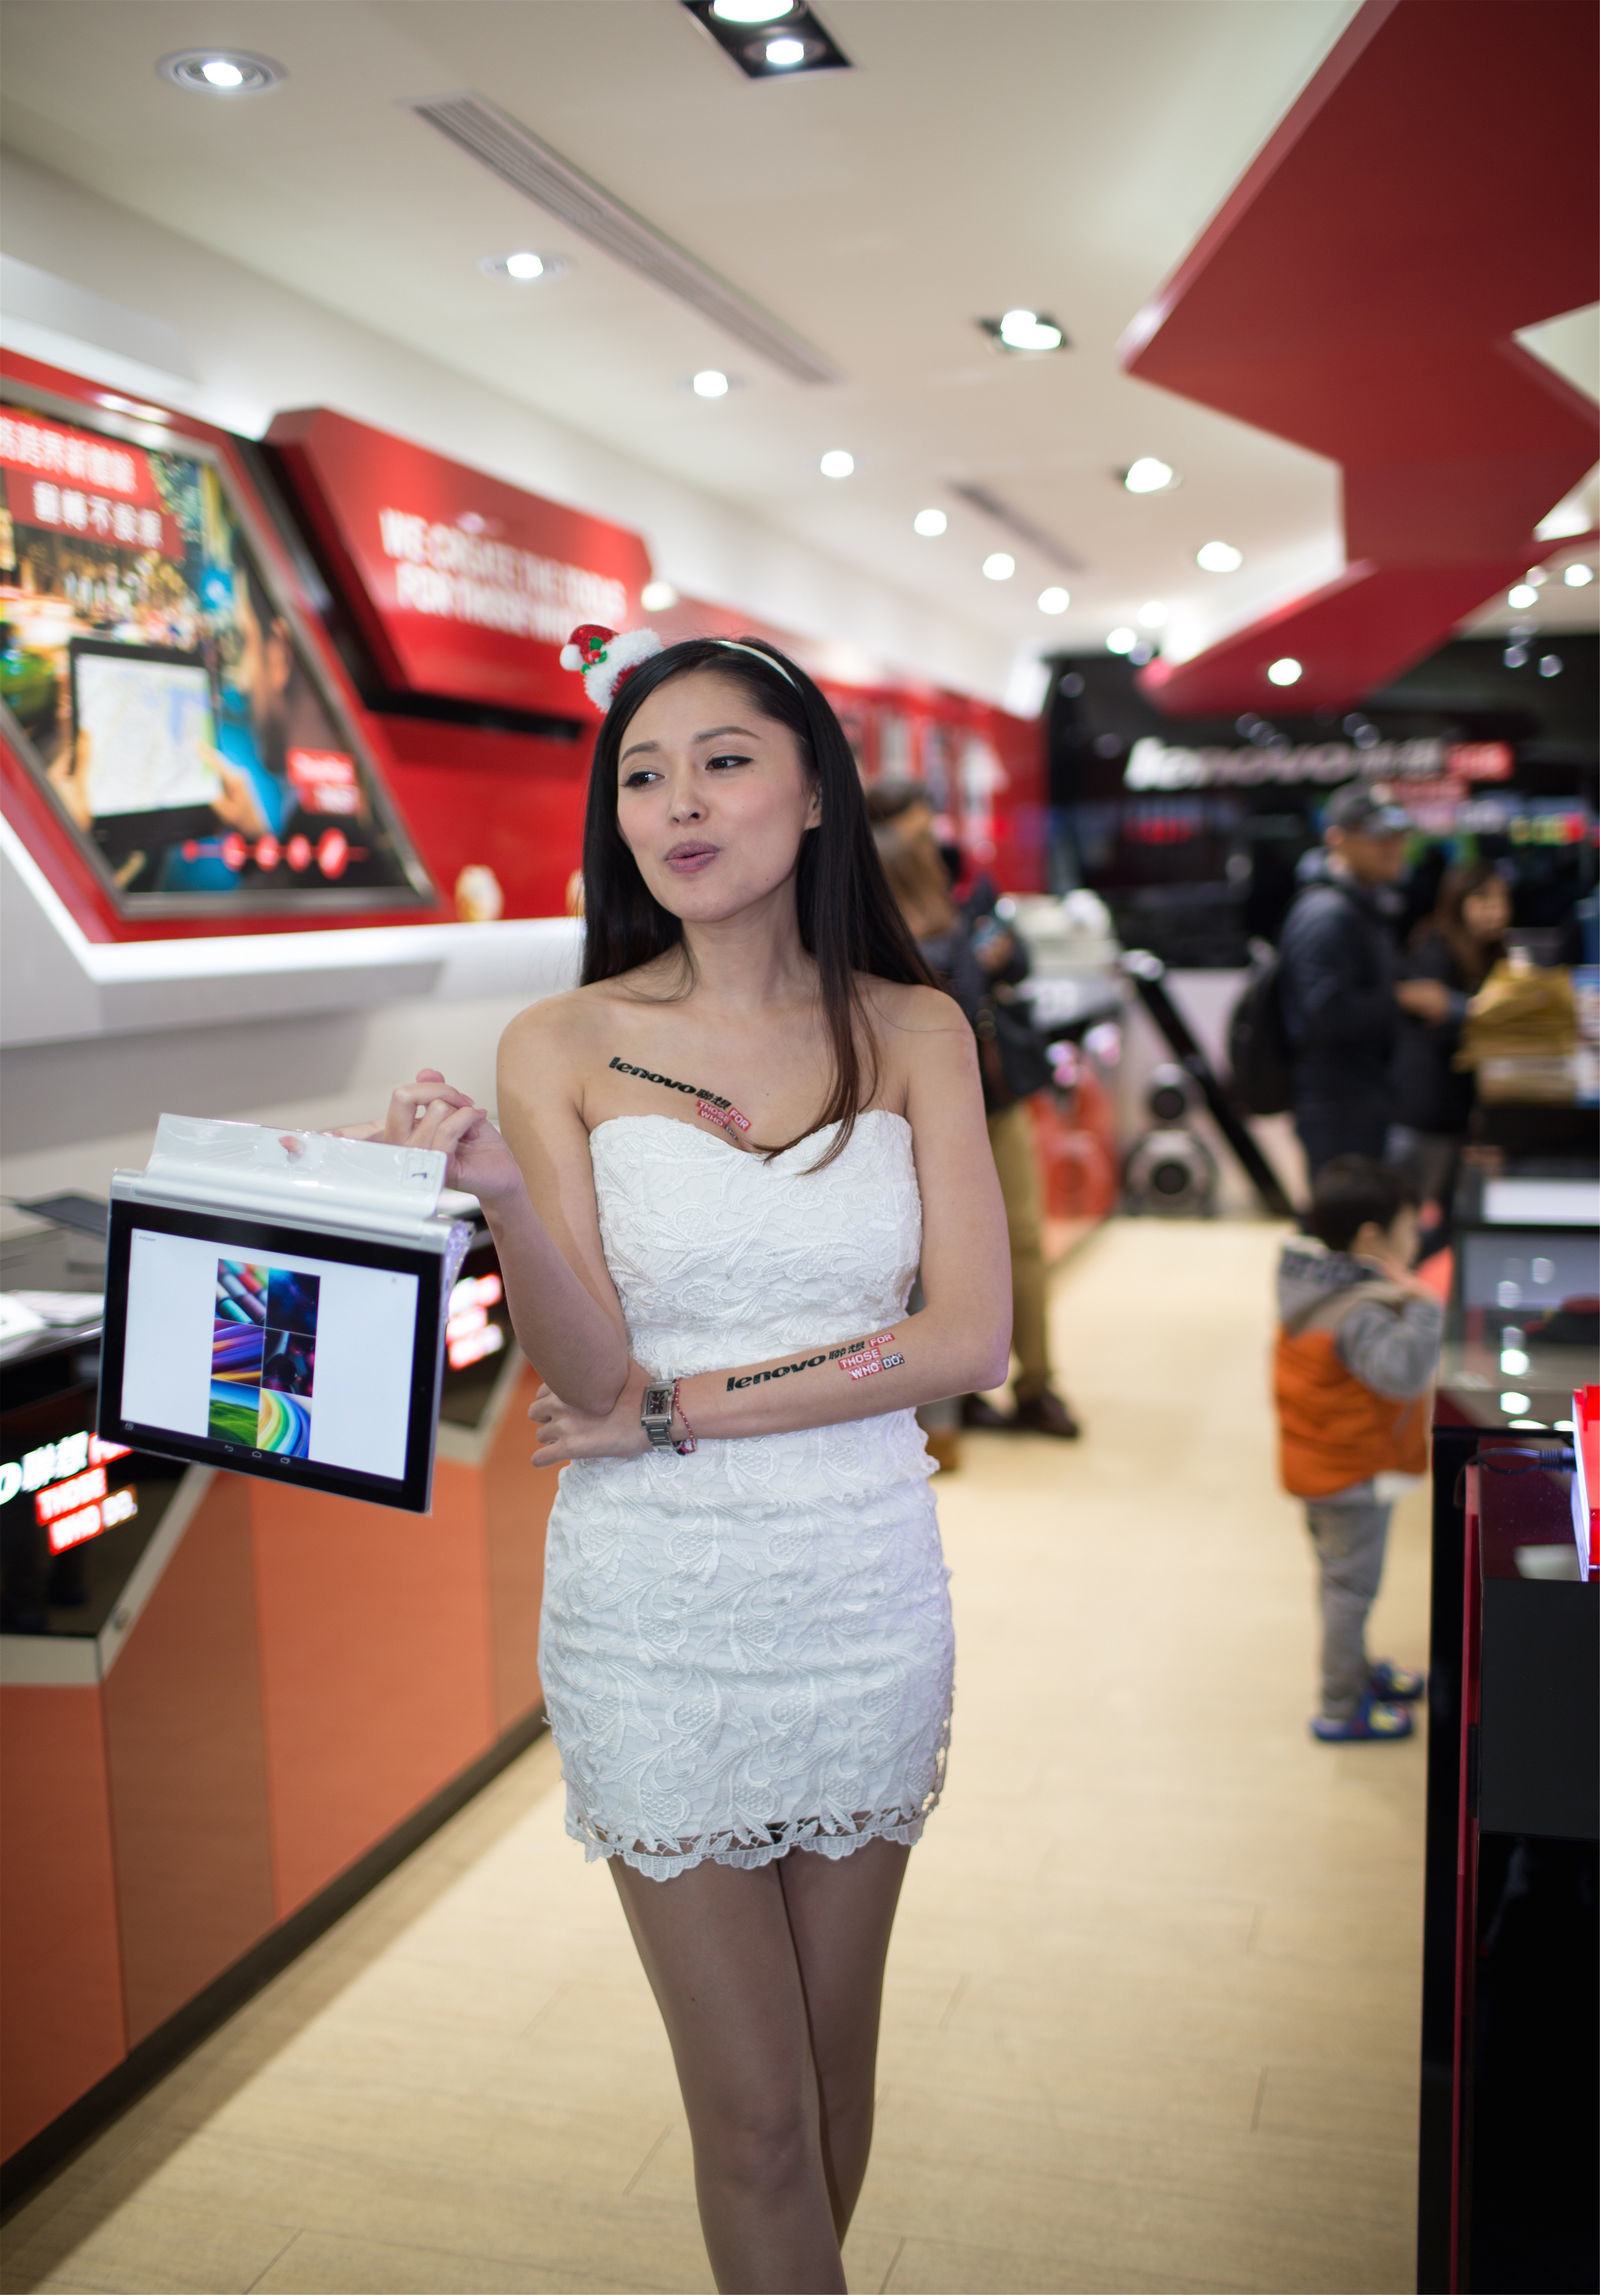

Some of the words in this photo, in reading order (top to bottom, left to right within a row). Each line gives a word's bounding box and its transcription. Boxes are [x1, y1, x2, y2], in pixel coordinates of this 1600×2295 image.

[608, 1056, 697, 1094] lenovo
[728, 1108, 750, 1131] FOR
[698, 1101, 730, 1123] THOSE
[699, 1110, 725, 1128] WHO
[726, 1354, 826, 1392] lenovo
[869, 1333, 893, 1347] FOR
[839, 1348, 880, 1369] THOSE
[849, 1361, 880, 1379] WHO
